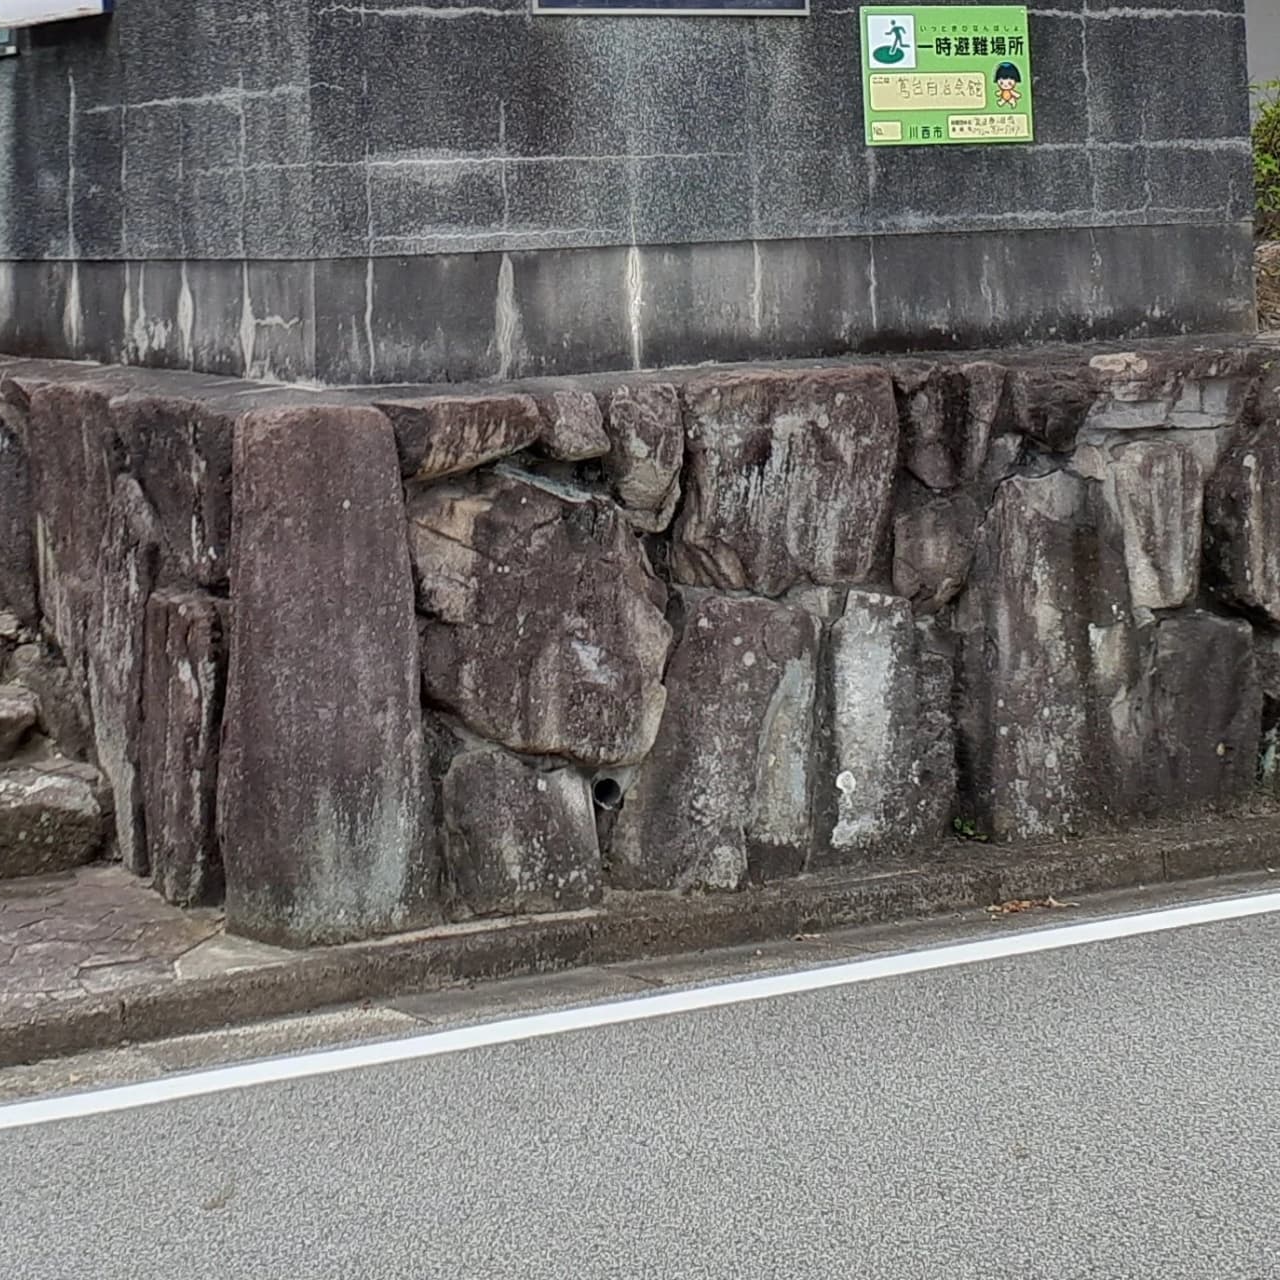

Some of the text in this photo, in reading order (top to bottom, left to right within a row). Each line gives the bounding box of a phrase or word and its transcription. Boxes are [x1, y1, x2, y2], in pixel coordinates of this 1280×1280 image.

[917, 36, 1024, 56] 一時避難場所
[909, 125, 943, 139] 川西市
